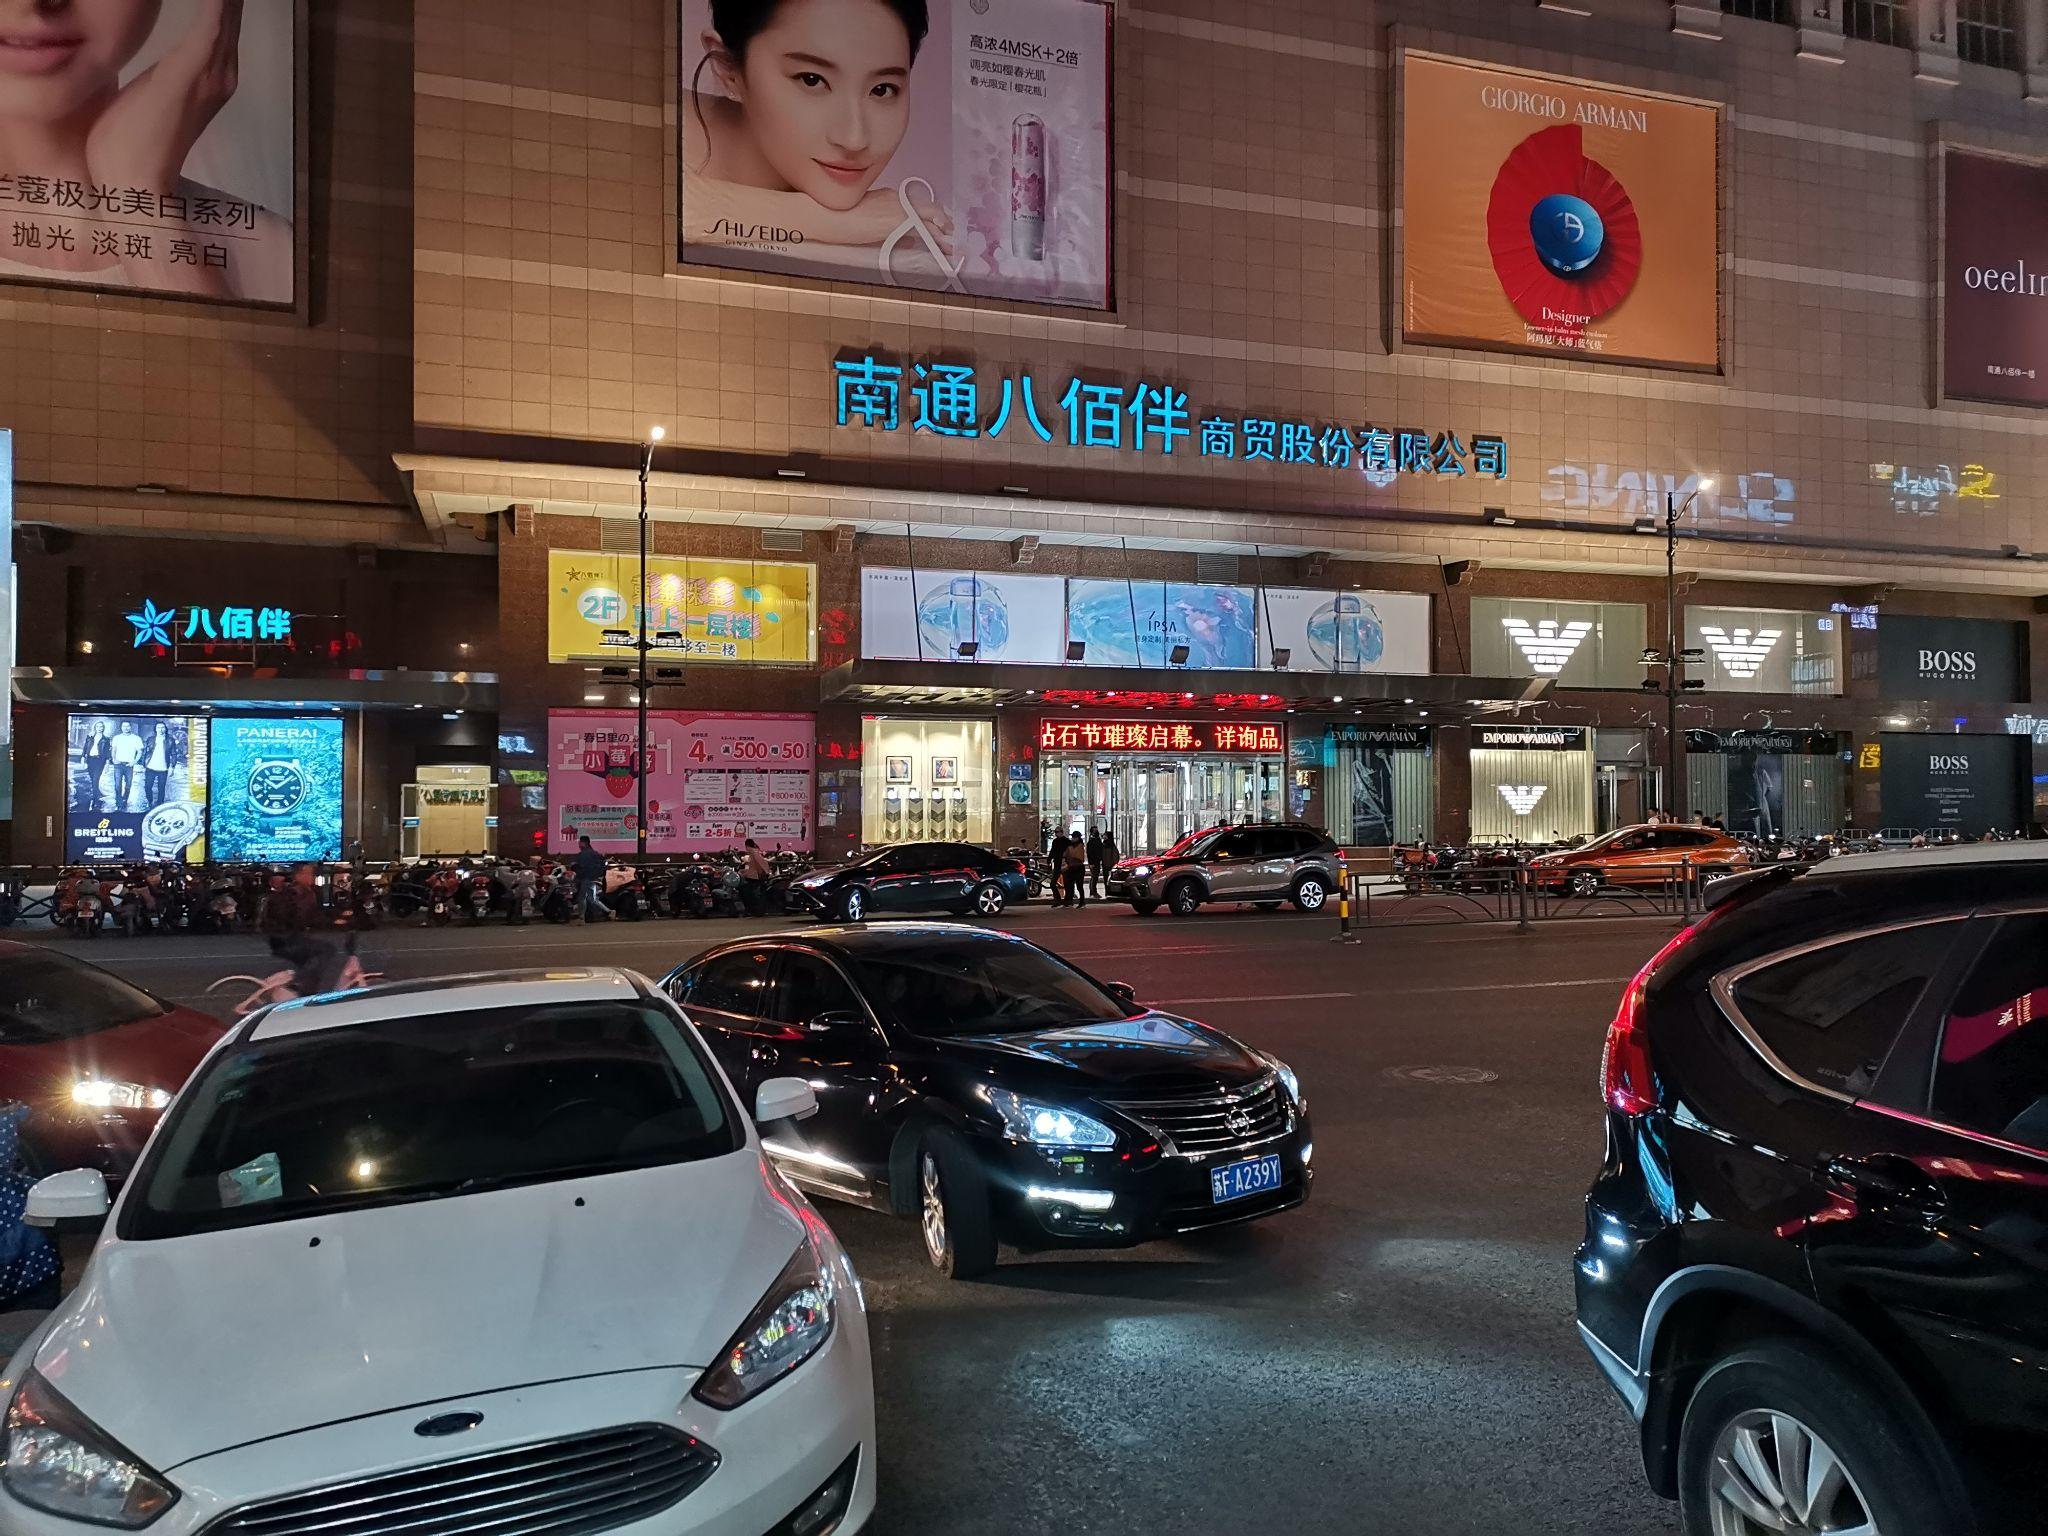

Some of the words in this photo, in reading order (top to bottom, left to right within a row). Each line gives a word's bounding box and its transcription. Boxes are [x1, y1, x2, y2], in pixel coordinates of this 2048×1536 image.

[1481, 86, 1566, 119] GIORGIO
[1574, 101, 1647, 133] ARMANI
[703, 218, 804, 244] SHISEIDO
[13, 221, 75, 252] 抛光
[93, 229, 153, 260] 淡斑
[170, 238, 228, 269] 亮白
[1542, 306, 1591, 327] Designer
[834, 355, 1190, 455] 南通八佰伴
[1200, 416, 1508, 479] 商贸股份有限公司
[584, 595, 621, 620] 2F
[184, 606, 291, 640] 八佰伴
[1918, 650, 1976, 672] BOSS
[237, 727, 318, 738] PANERAI
[1042, 722, 1283, 750] 钻石节璀璨启幕。详询品
[1331, 731, 1372, 742] EMPORIO
[1382, 731, 1417, 742] ARMANI
[1483, 732, 1522, 744] EMPORIO
[1531, 733, 1565, 744] ARMANI
[1930, 755, 1969, 770] BOSS
[74, 829, 135, 837] BREITLING
